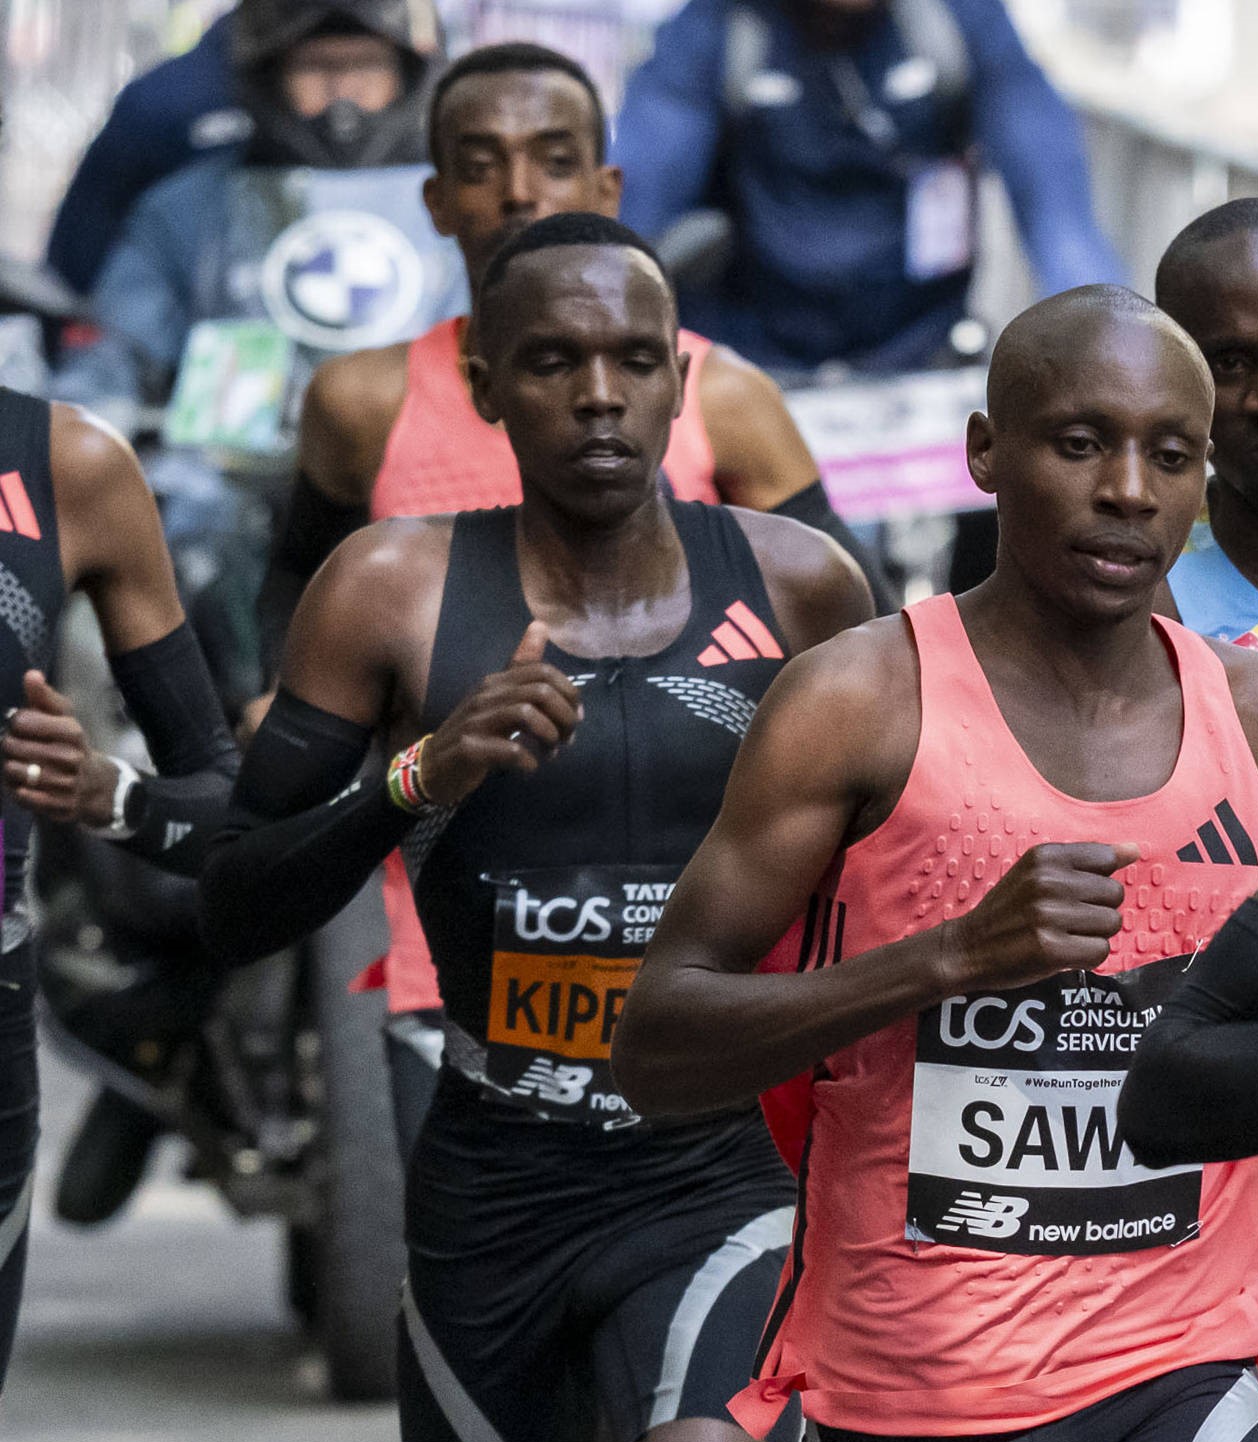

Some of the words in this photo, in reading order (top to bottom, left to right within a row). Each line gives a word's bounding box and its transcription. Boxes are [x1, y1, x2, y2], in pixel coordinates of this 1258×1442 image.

[514, 888, 612, 942] tcs
[1061, 987, 1123, 1006] TATA
[939, 995, 1046, 1051] tcs
[1060, 1005, 1162, 1028] CONSULTA
[1025, 1077, 1122, 1091] #WeRunTogether
[958, 1100, 1142, 1171] SAW
[1029, 1222, 1077, 1242] new
[1085, 1212, 1176, 1243] balance
